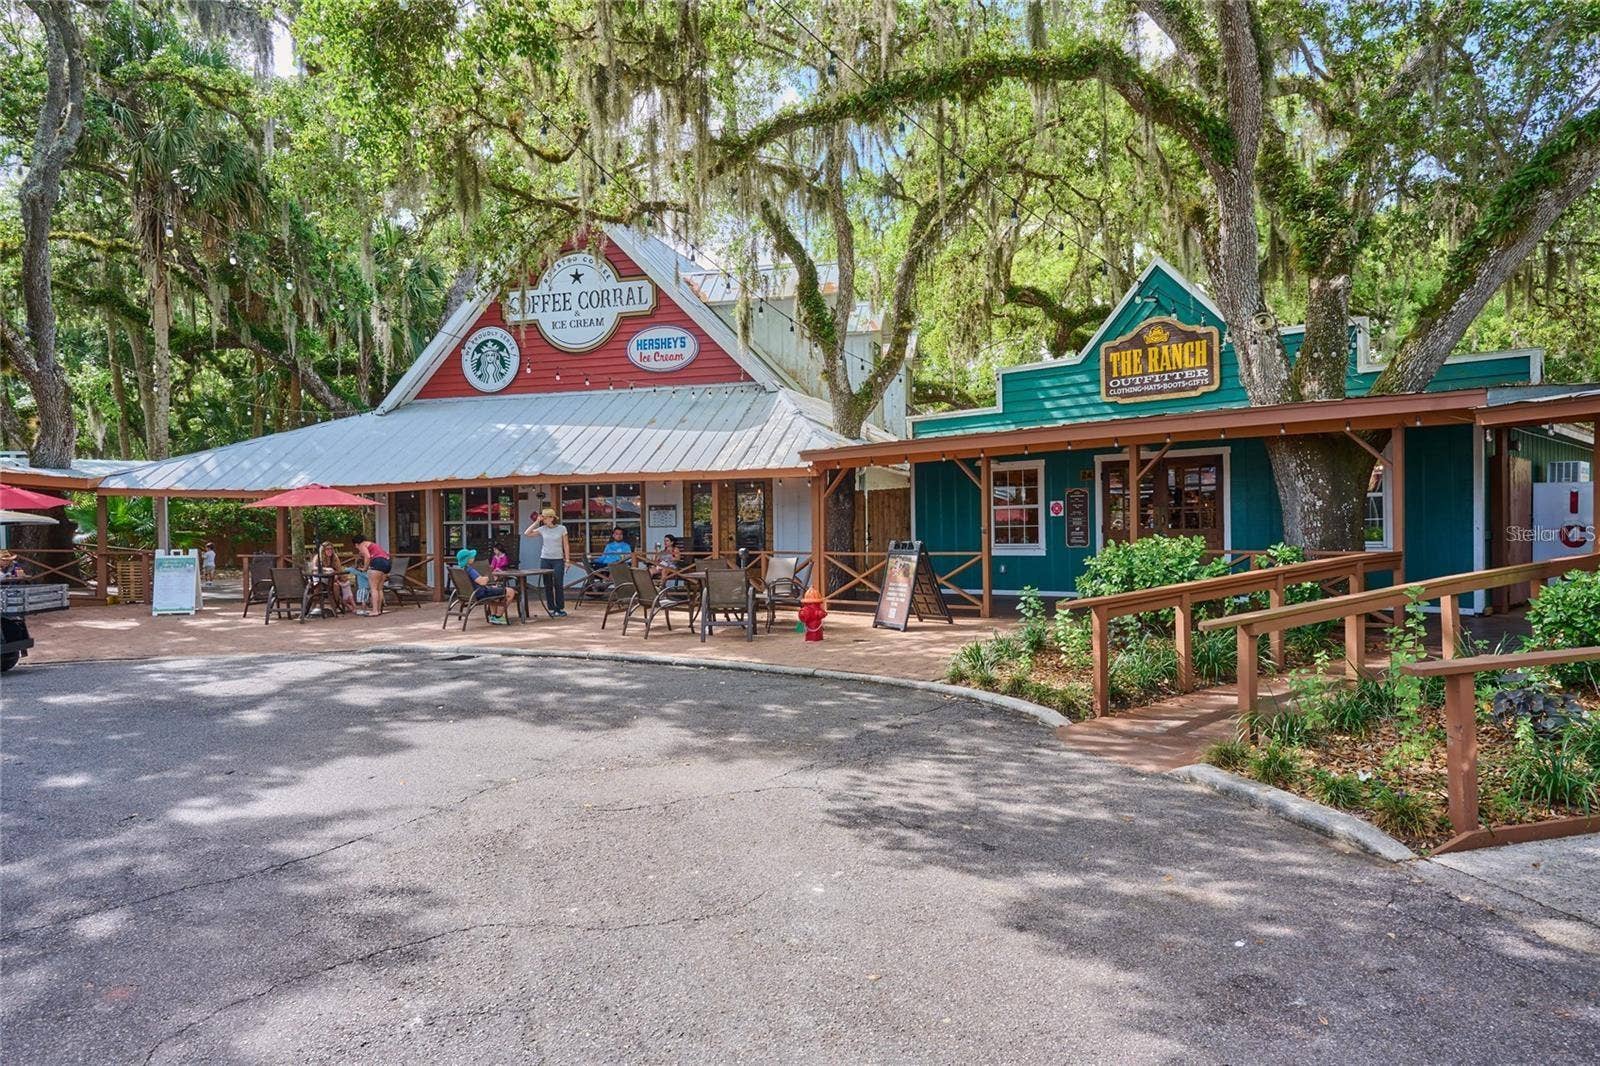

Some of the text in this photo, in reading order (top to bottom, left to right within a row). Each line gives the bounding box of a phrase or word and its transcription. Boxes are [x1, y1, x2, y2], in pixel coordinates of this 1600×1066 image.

[578, 286, 648, 309] CORRAL
[552, 317, 605, 330] ICE CREAM
[636, 336, 686, 350] HERSHEY'S
[639, 351, 685, 363] Ice Cream
[1110, 340, 1207, 377] THE RANCH
[1109, 368, 1209, 388] OUTFITTER
